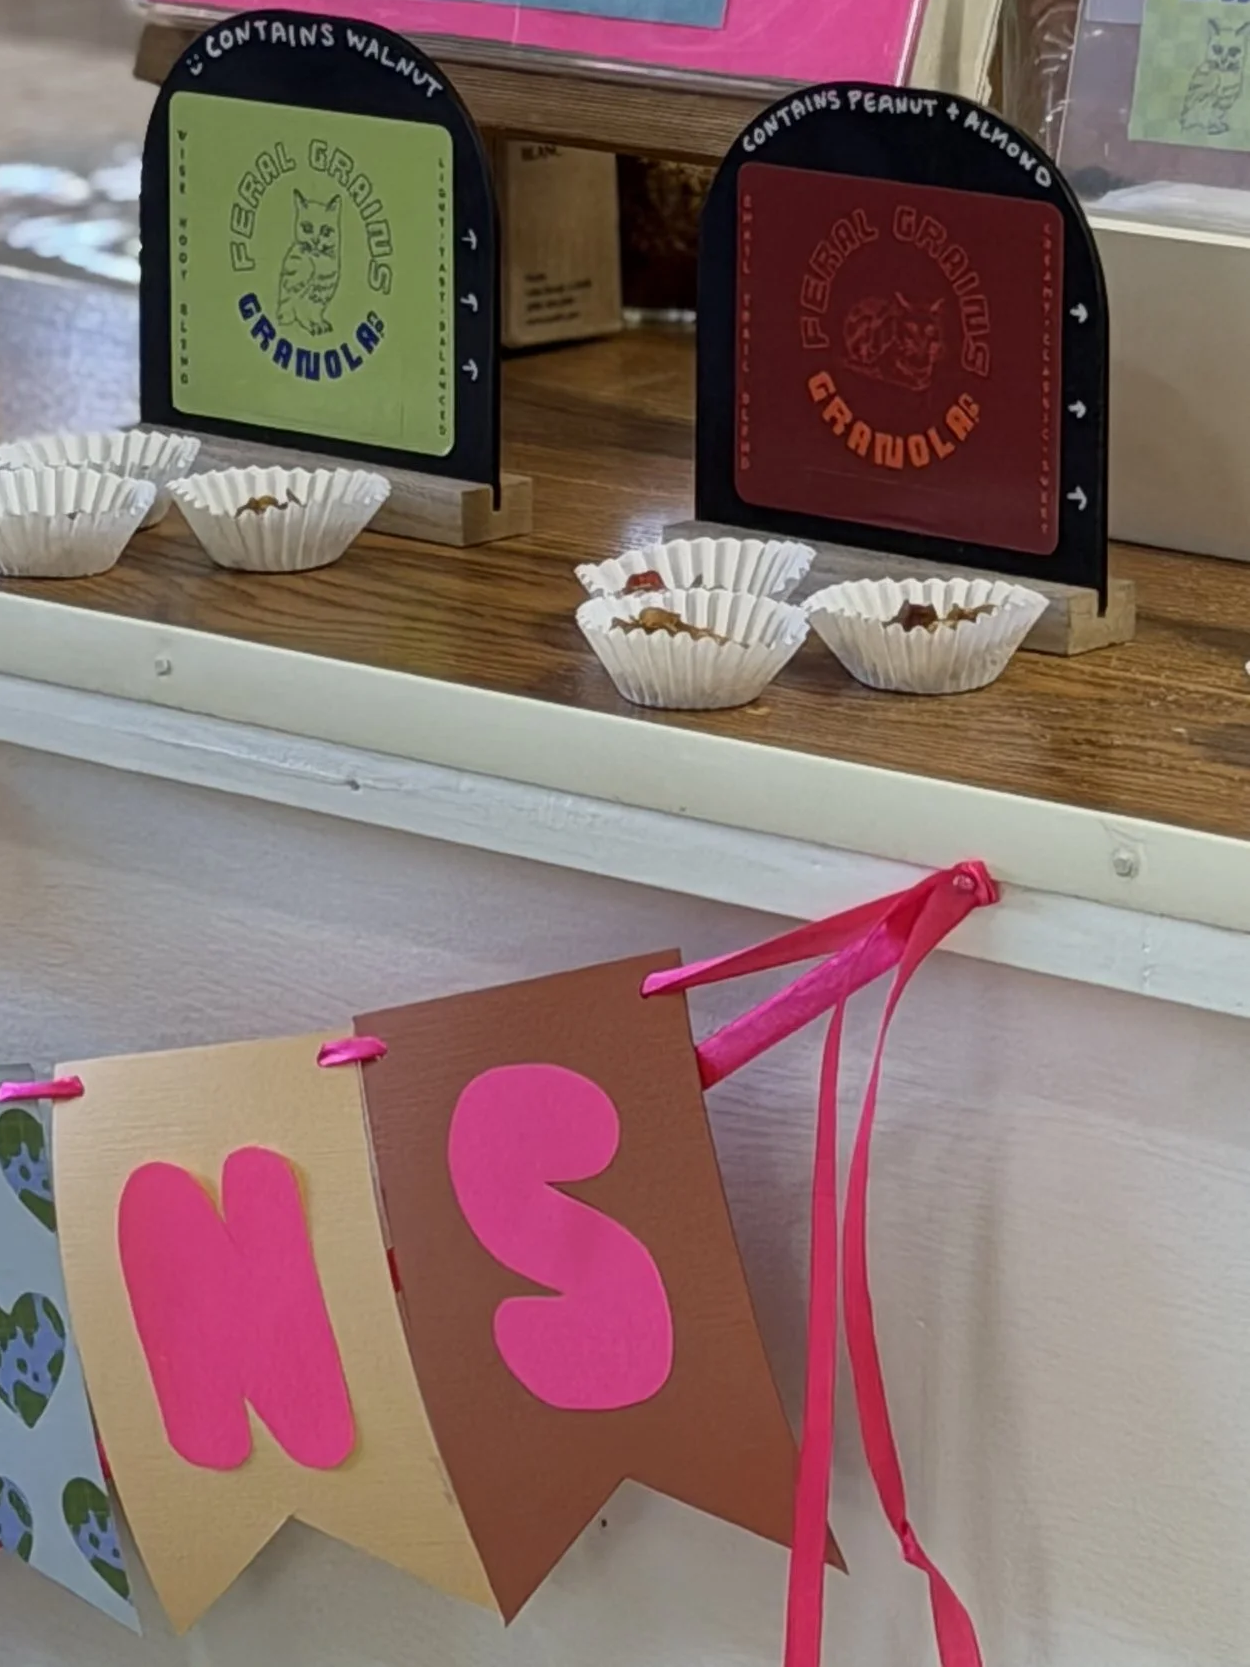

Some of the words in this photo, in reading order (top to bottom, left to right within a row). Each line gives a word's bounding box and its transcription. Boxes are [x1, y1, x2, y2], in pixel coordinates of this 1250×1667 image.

[204, 19, 335, 59] CONTAINS
[346, 28, 444, 99] WALNUT
[741, 89, 841, 153] CONTAINS
[847, 89, 939, 118] PEANUT
[963, 110, 1053, 188] ALMOND
[230, 140, 297, 272] FERAL
[307, 138, 394, 296] GRAINS
[237, 291, 383, 382] GRANOLA
[800, 208, 879, 350] FERAL
[893, 204, 992, 378] GRAINS
[807, 369, 975, 470] GRANOLA
